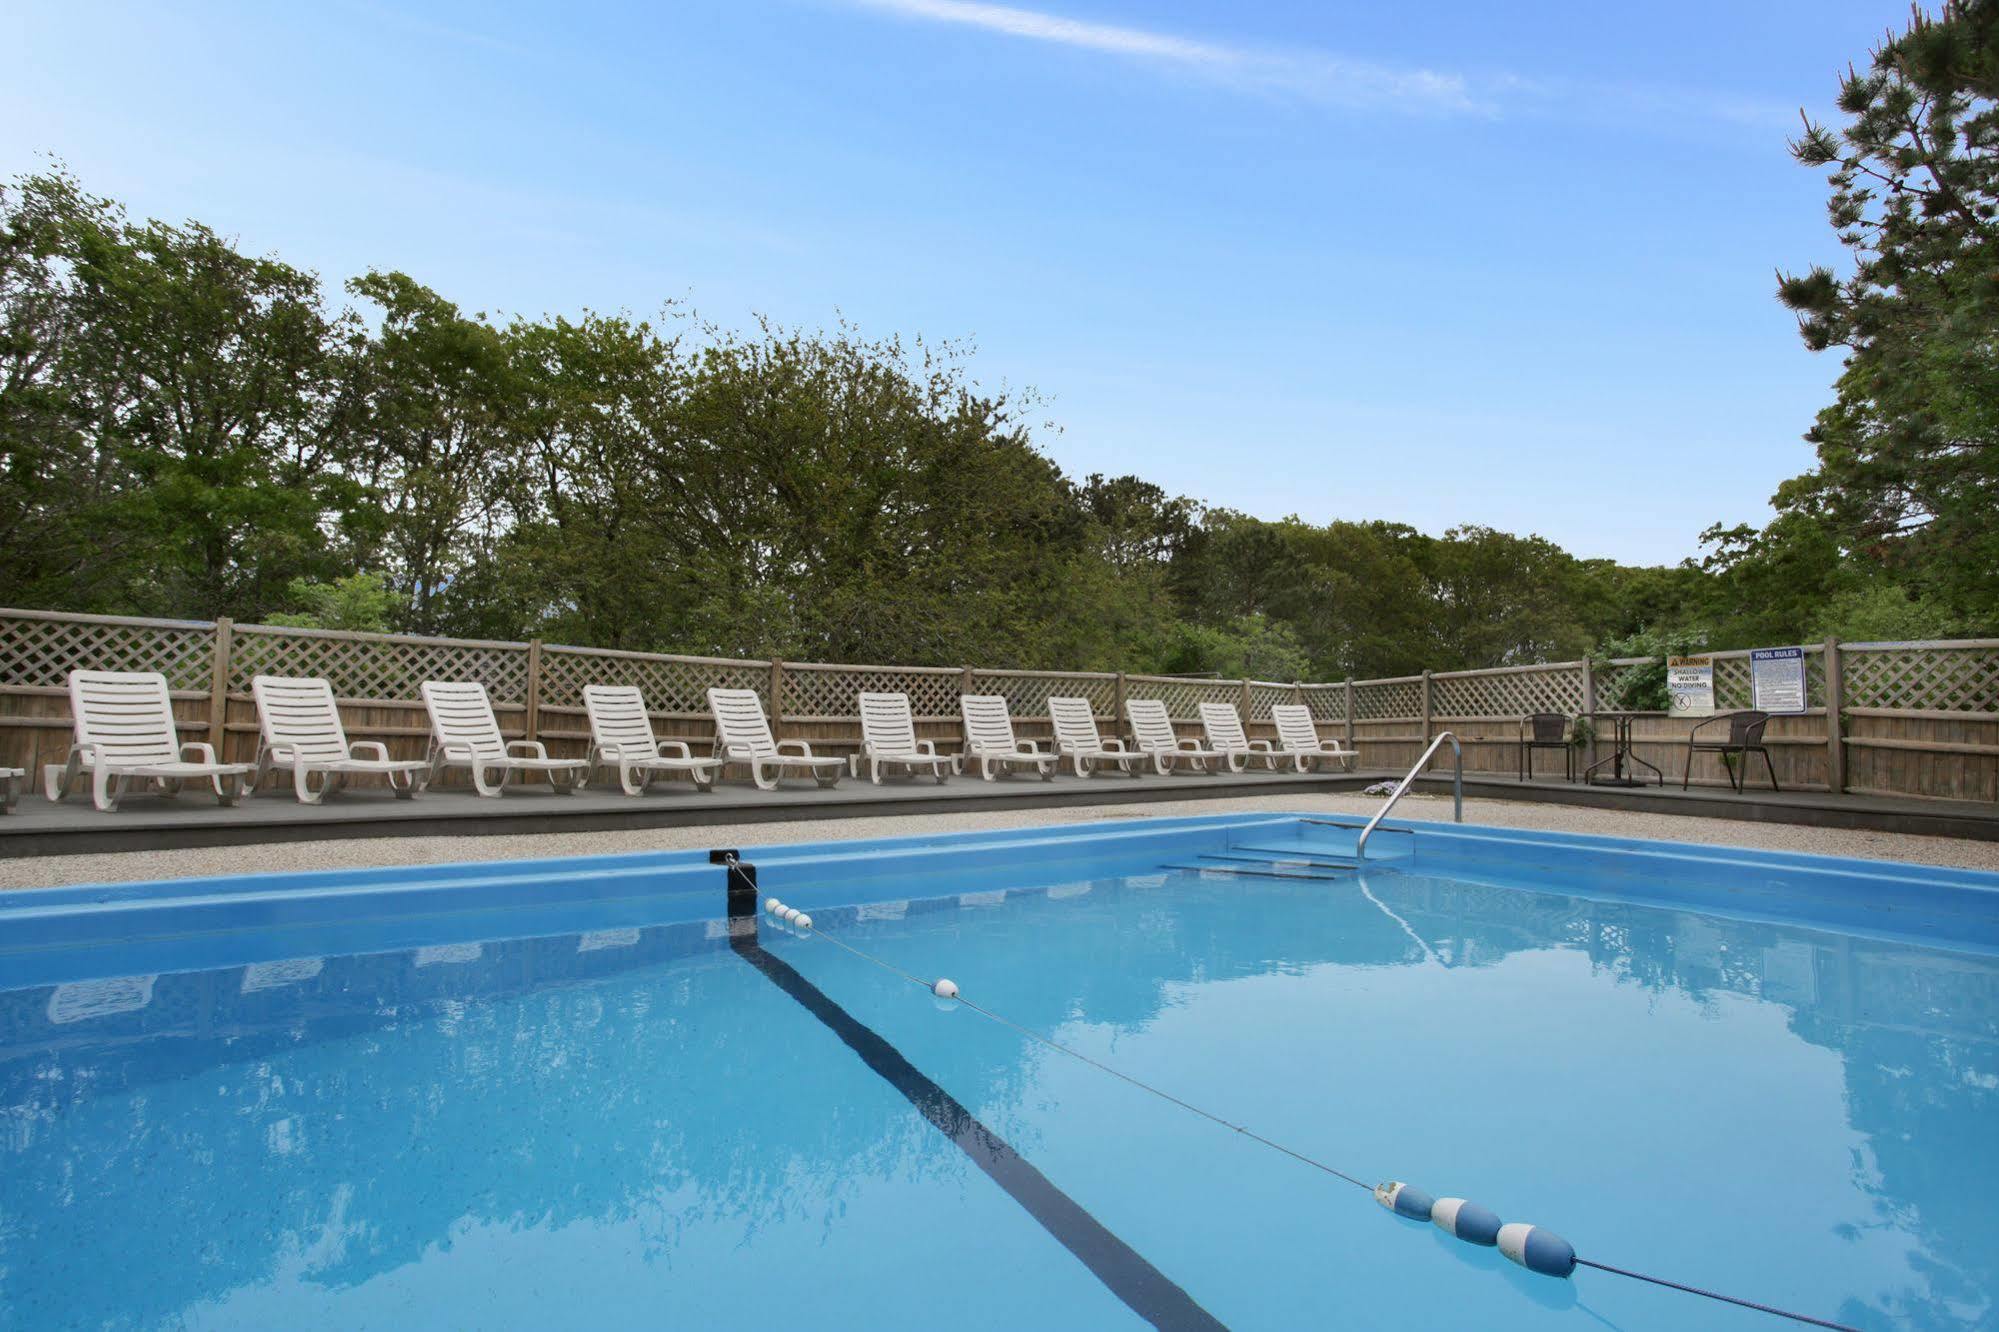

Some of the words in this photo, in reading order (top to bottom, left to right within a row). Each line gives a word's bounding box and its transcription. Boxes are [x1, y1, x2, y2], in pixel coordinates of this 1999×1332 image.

[1755, 651, 1773, 659] POOL
[1774, 650, 1797, 658] RULES
[1679, 657, 1710, 667] WARNING
